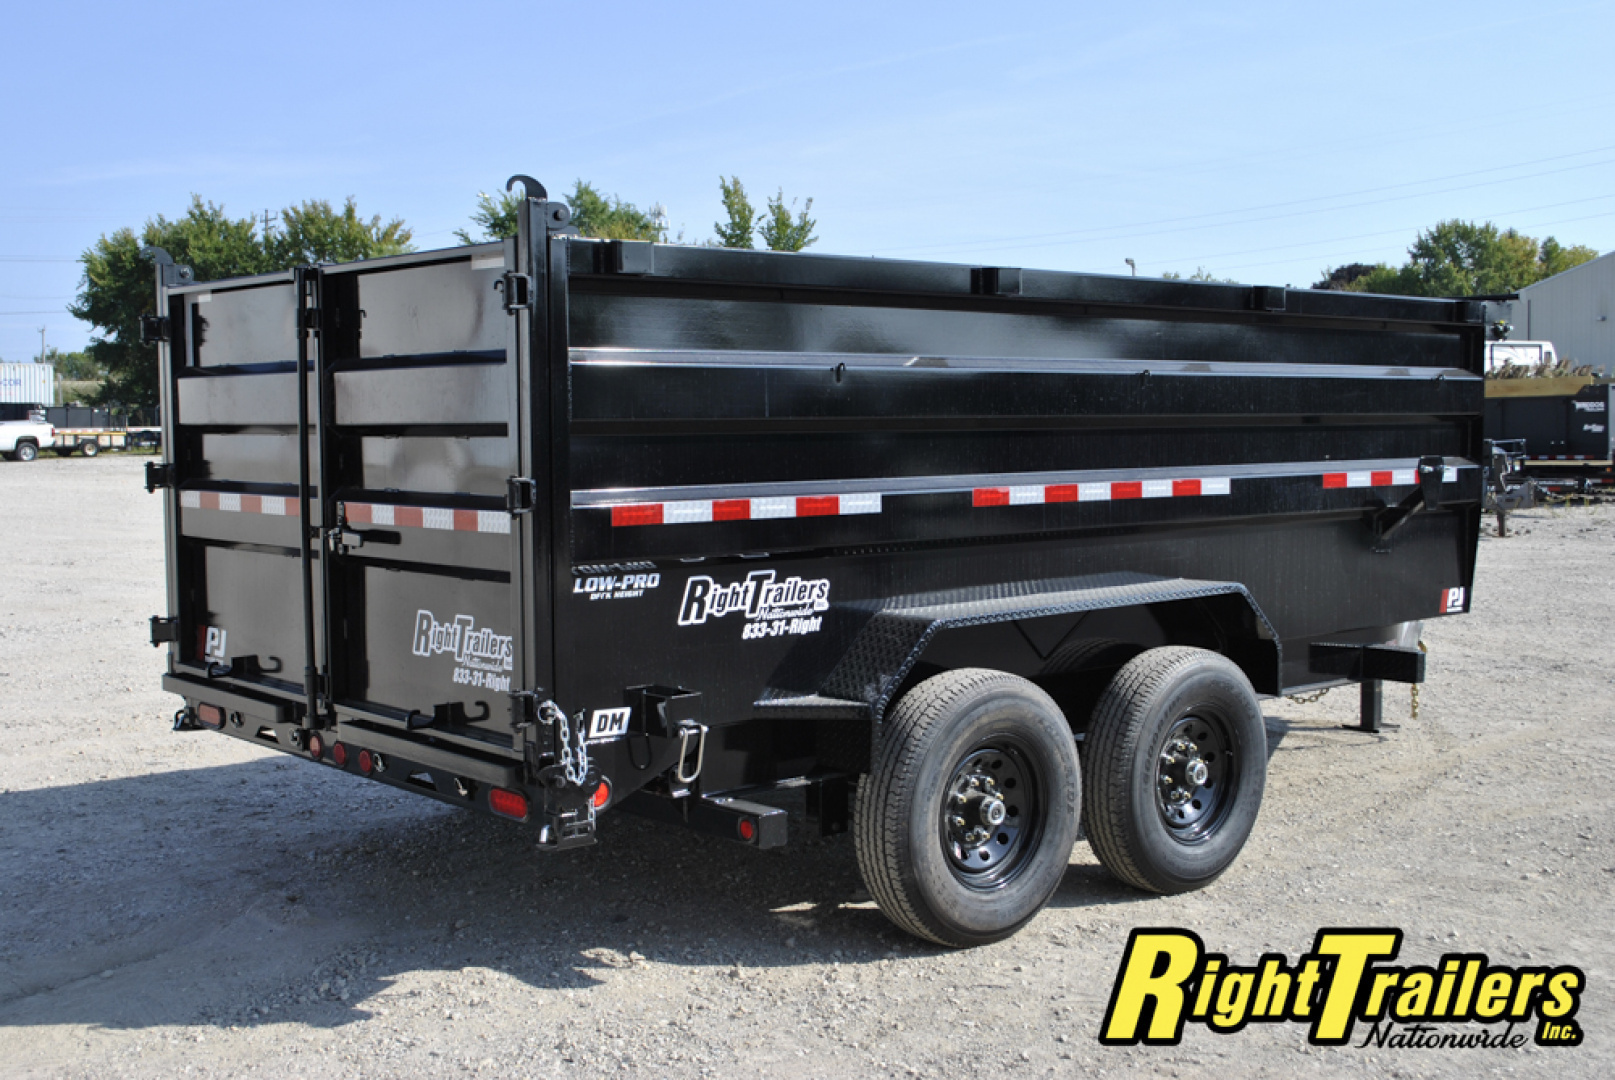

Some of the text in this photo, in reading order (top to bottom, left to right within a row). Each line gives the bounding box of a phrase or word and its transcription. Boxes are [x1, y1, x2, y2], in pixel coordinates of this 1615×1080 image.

[573, 572, 661, 594] LOW-PRO
[613, 589, 644, 599] HEIGHT
[1447, 586, 1465, 607] PJ
[741, 616, 822, 640] 833-31-Right
[205, 626, 227, 658] PJ
[453, 667, 510, 692] 833-31-Right
[596, 711, 626, 733] DM
